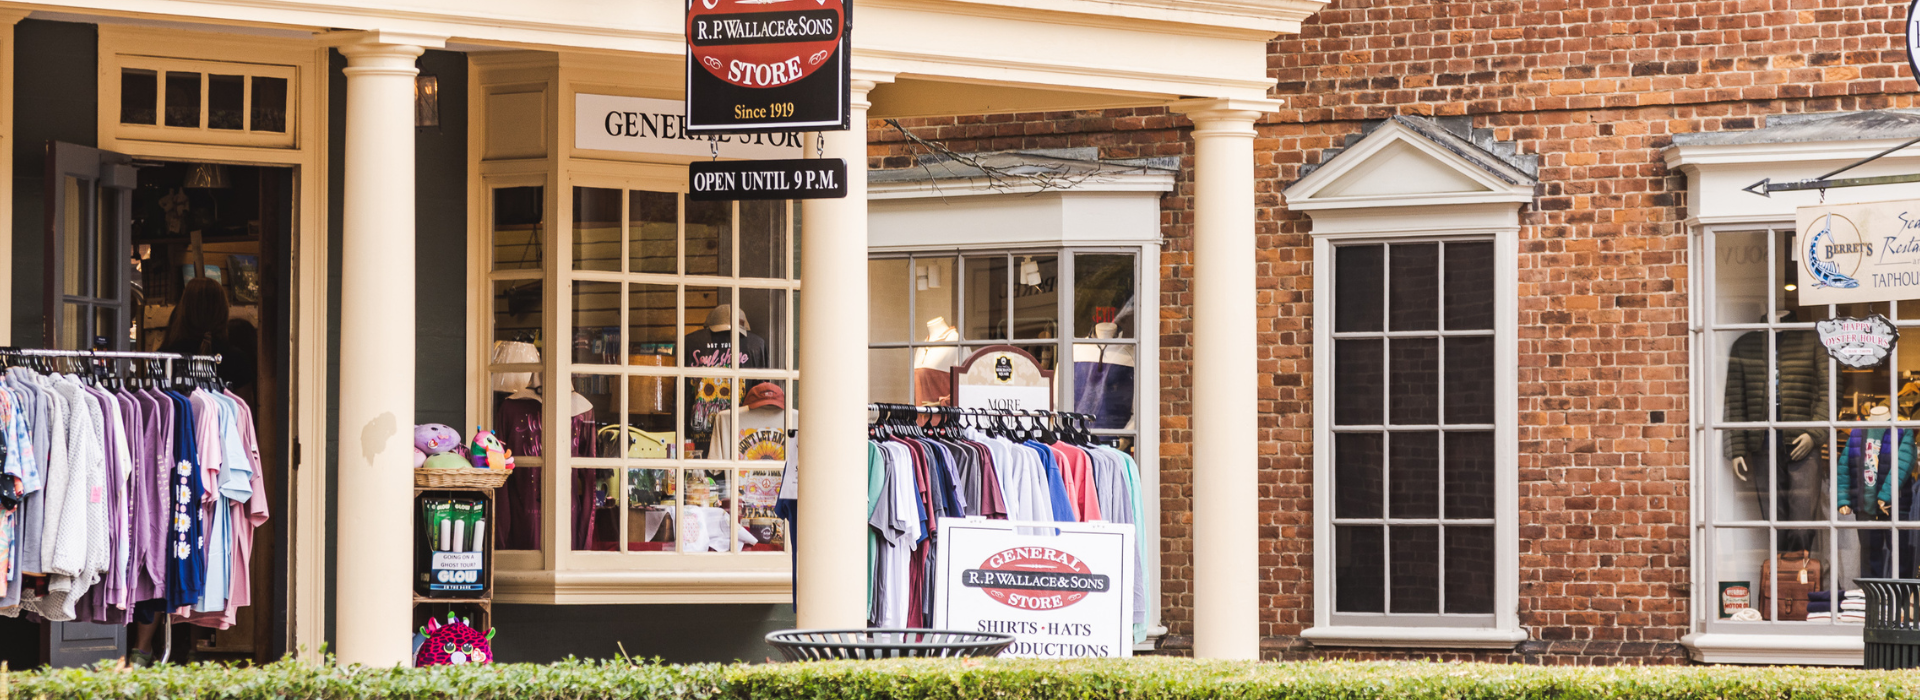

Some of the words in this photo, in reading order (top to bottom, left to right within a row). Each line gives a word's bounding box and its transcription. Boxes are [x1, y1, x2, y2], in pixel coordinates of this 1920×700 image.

[728, 56, 803, 86] STORE
[734, 104, 766, 120] Since
[770, 102, 794, 118] 1919
[604, 110, 731, 143] GENER
[694, 172, 736, 192] OPEN
[741, 171, 790, 191] UNTIL
[794, 171, 802, 189] 9
[806, 170, 838, 189] P.M.
[1825, 242, 1873, 260] BERRET'S
[1880, 236, 1920, 264] Resta
[1872, 271, 1920, 288] TAPHOU
[1843, 323, 1870, 331] HAPPY
[1825, 334, 1857, 346] OYSTER
[1860, 335, 1888, 346] HOURS
[988, 398, 1020, 411] MORE
[990, 547, 1081, 572] GENERAL
[438, 570, 477, 583] GLOW
[1008, 592, 1063, 609] STORE
[978, 620, 1038, 634] SHIRTS
[1048, 623, 1091, 636] HATS
[1002, 642, 1109, 657] ODUCTIONS
